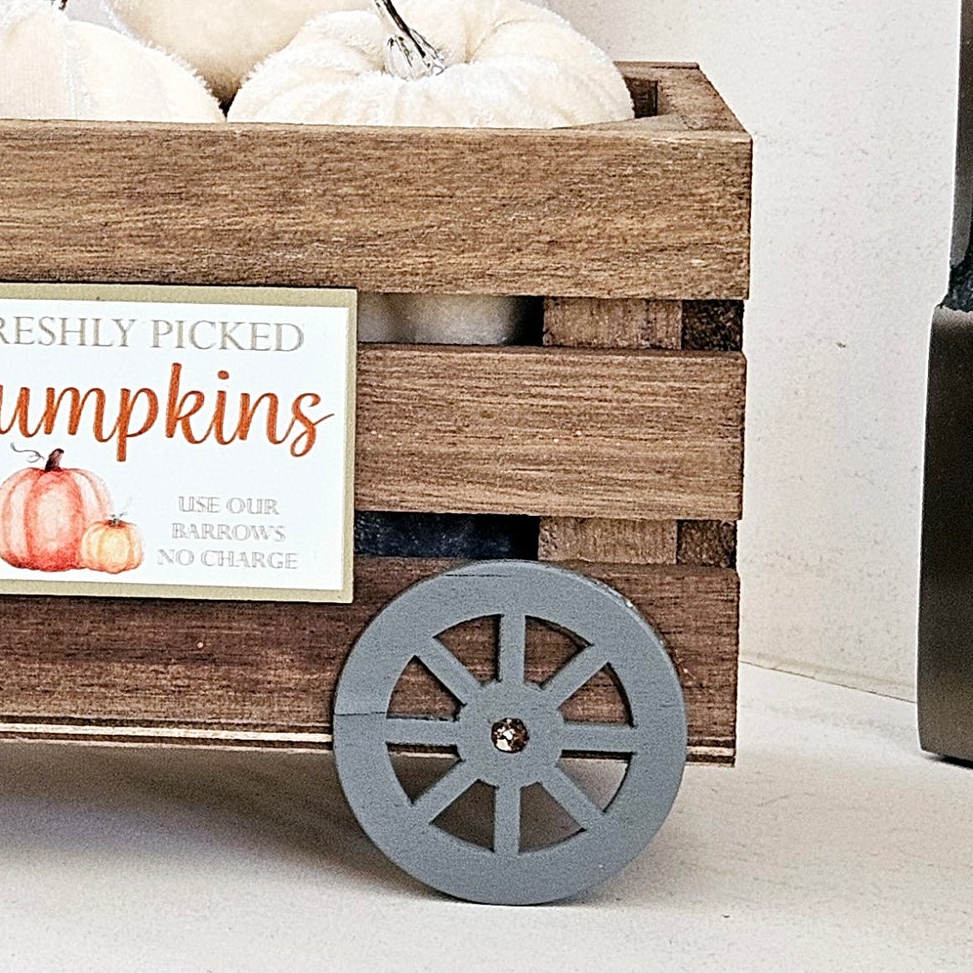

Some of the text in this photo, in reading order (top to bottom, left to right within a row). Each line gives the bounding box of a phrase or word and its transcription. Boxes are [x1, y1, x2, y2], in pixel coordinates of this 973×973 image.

[151, 319, 306, 352] PICKED
[178, 495, 280, 516] USE OUR
[171, 522, 286, 542] BARROWS
[157, 548, 299, 569] NO CHARGE
